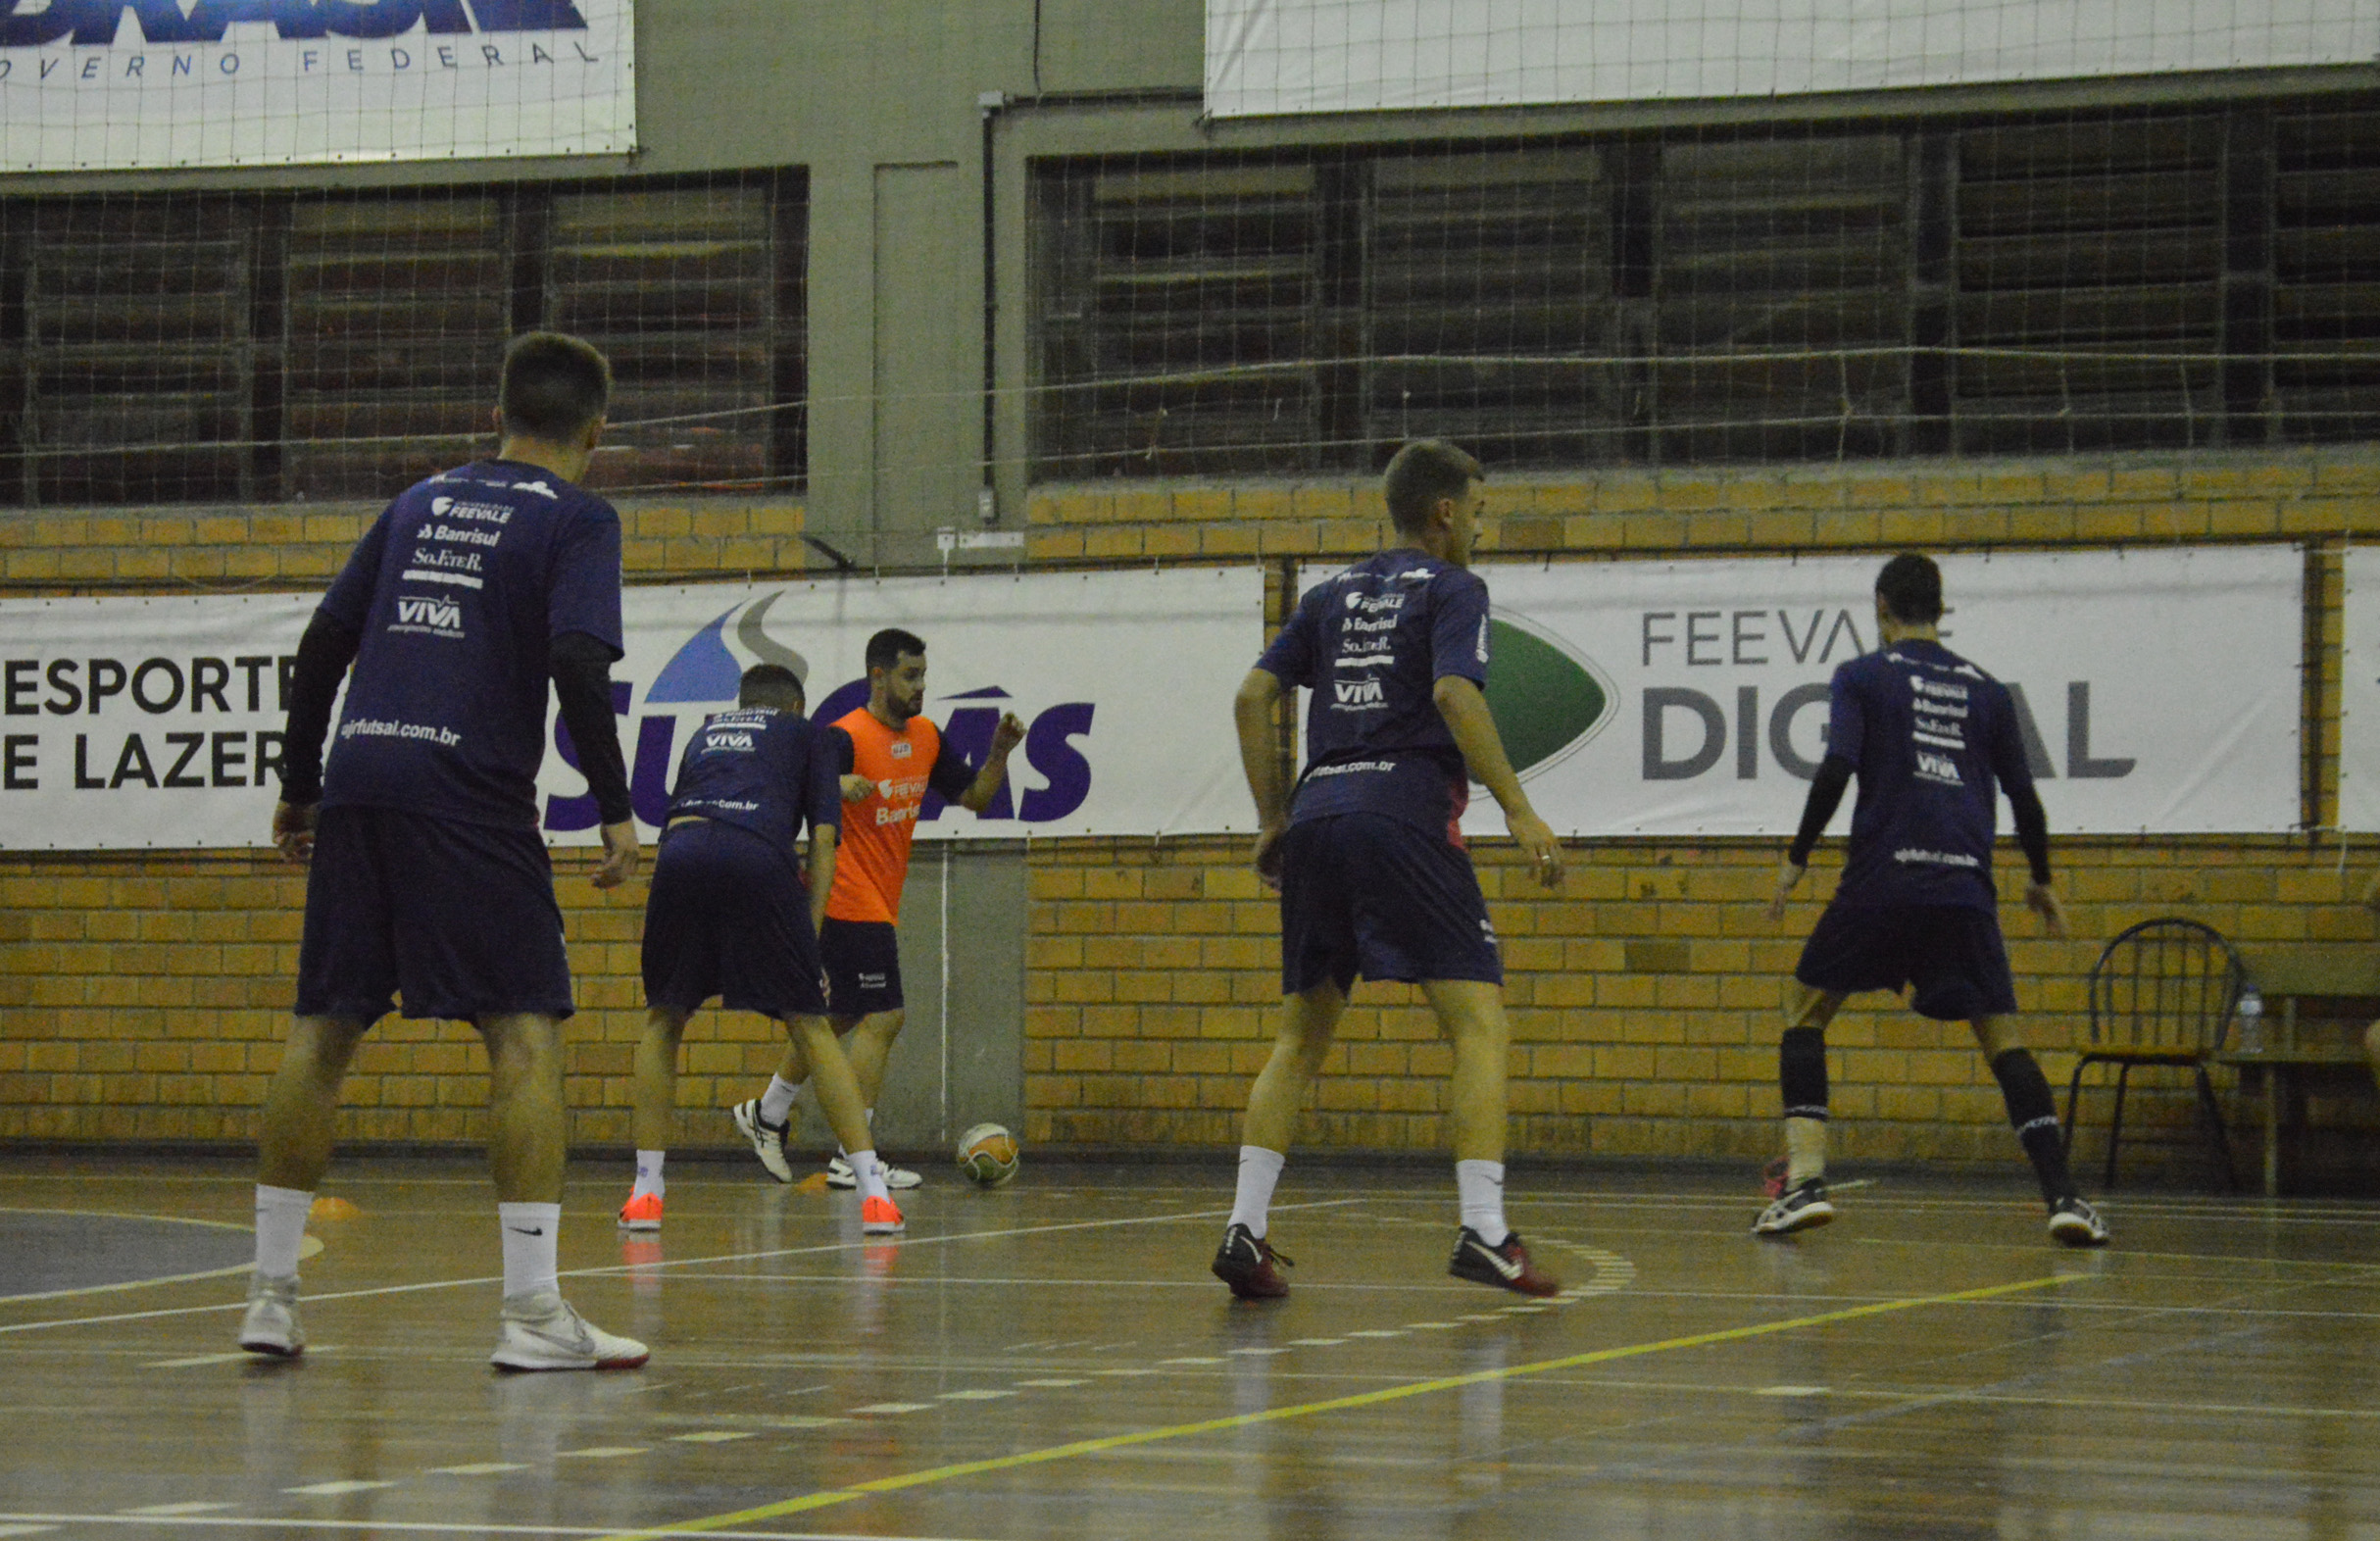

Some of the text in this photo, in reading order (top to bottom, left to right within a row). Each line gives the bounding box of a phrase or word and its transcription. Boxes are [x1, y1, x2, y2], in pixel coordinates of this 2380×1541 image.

[302, 41, 599, 71] FEDERAL
[449, 506, 512, 524] FEEVALE
[434, 524, 502, 548] Banrisul
[398, 600, 461, 629] VIVA
[1642, 606, 1955, 668] FEEVA
[706, 733, 754, 747] VIVA
[1642, 679, 2138, 780] DIGL
[3, 731, 289, 790] E LAZER
